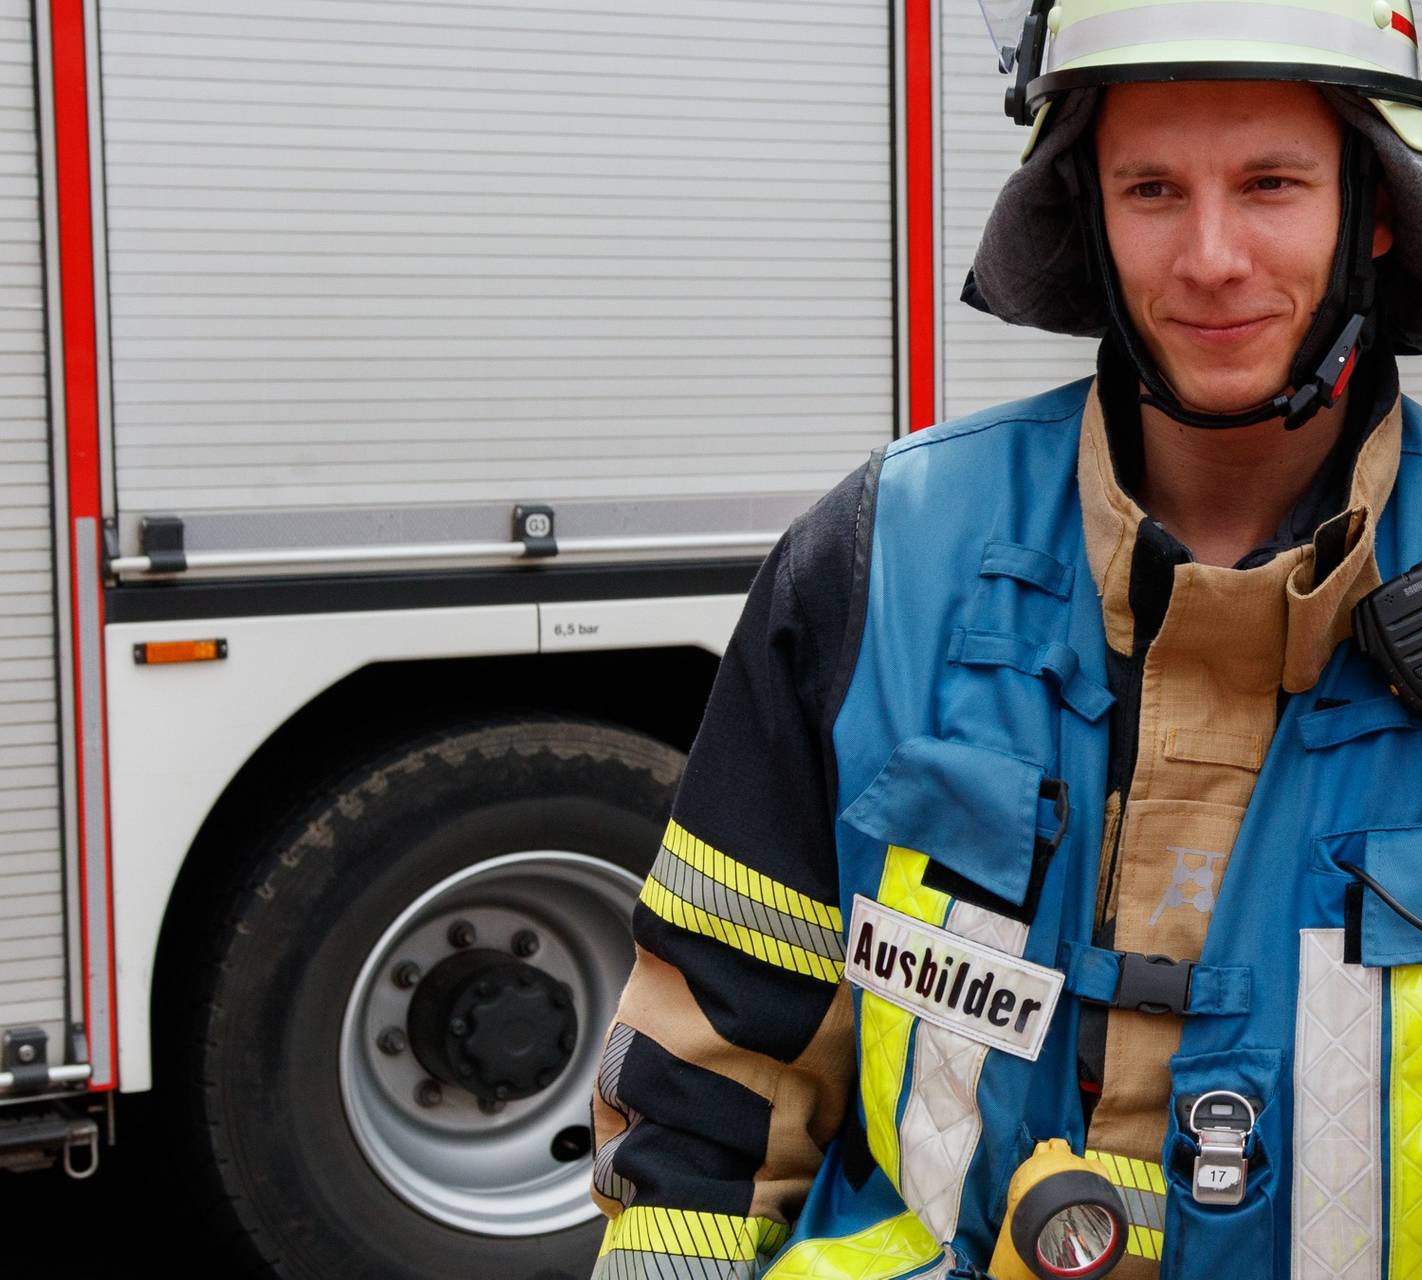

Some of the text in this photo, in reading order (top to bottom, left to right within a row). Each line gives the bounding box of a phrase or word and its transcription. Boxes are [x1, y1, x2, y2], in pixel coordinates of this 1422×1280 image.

[553, 622, 600, 637] 6,5 bar
[853, 921, 1042, 1034] Ausbilder
[1210, 1170, 1227, 1183] 17
